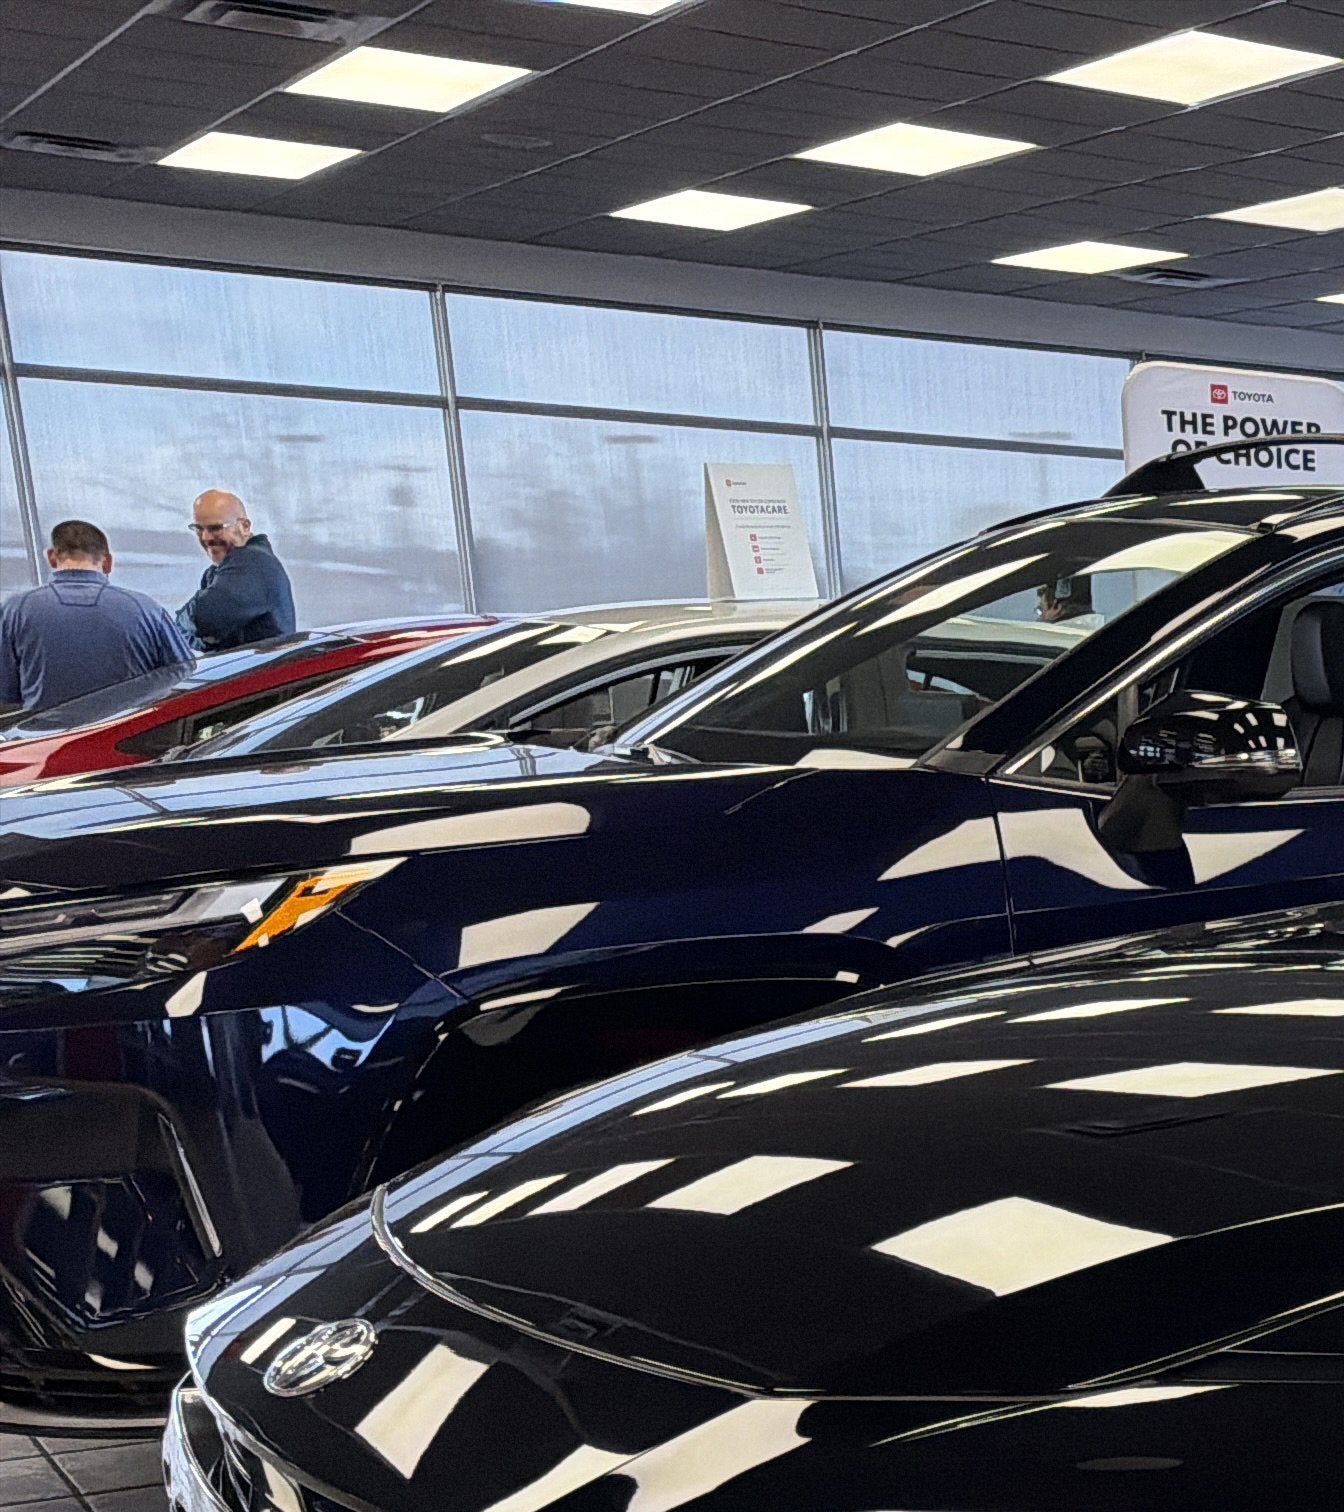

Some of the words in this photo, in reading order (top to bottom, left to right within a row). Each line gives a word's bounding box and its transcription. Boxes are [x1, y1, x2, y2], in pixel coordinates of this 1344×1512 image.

[1231, 390, 1274, 404] TOYOTA
[1161, 409, 1216, 436] THE
[1215, 447, 1316, 472] CHOICE
[730, 504, 789, 514] TOYOTACARE
